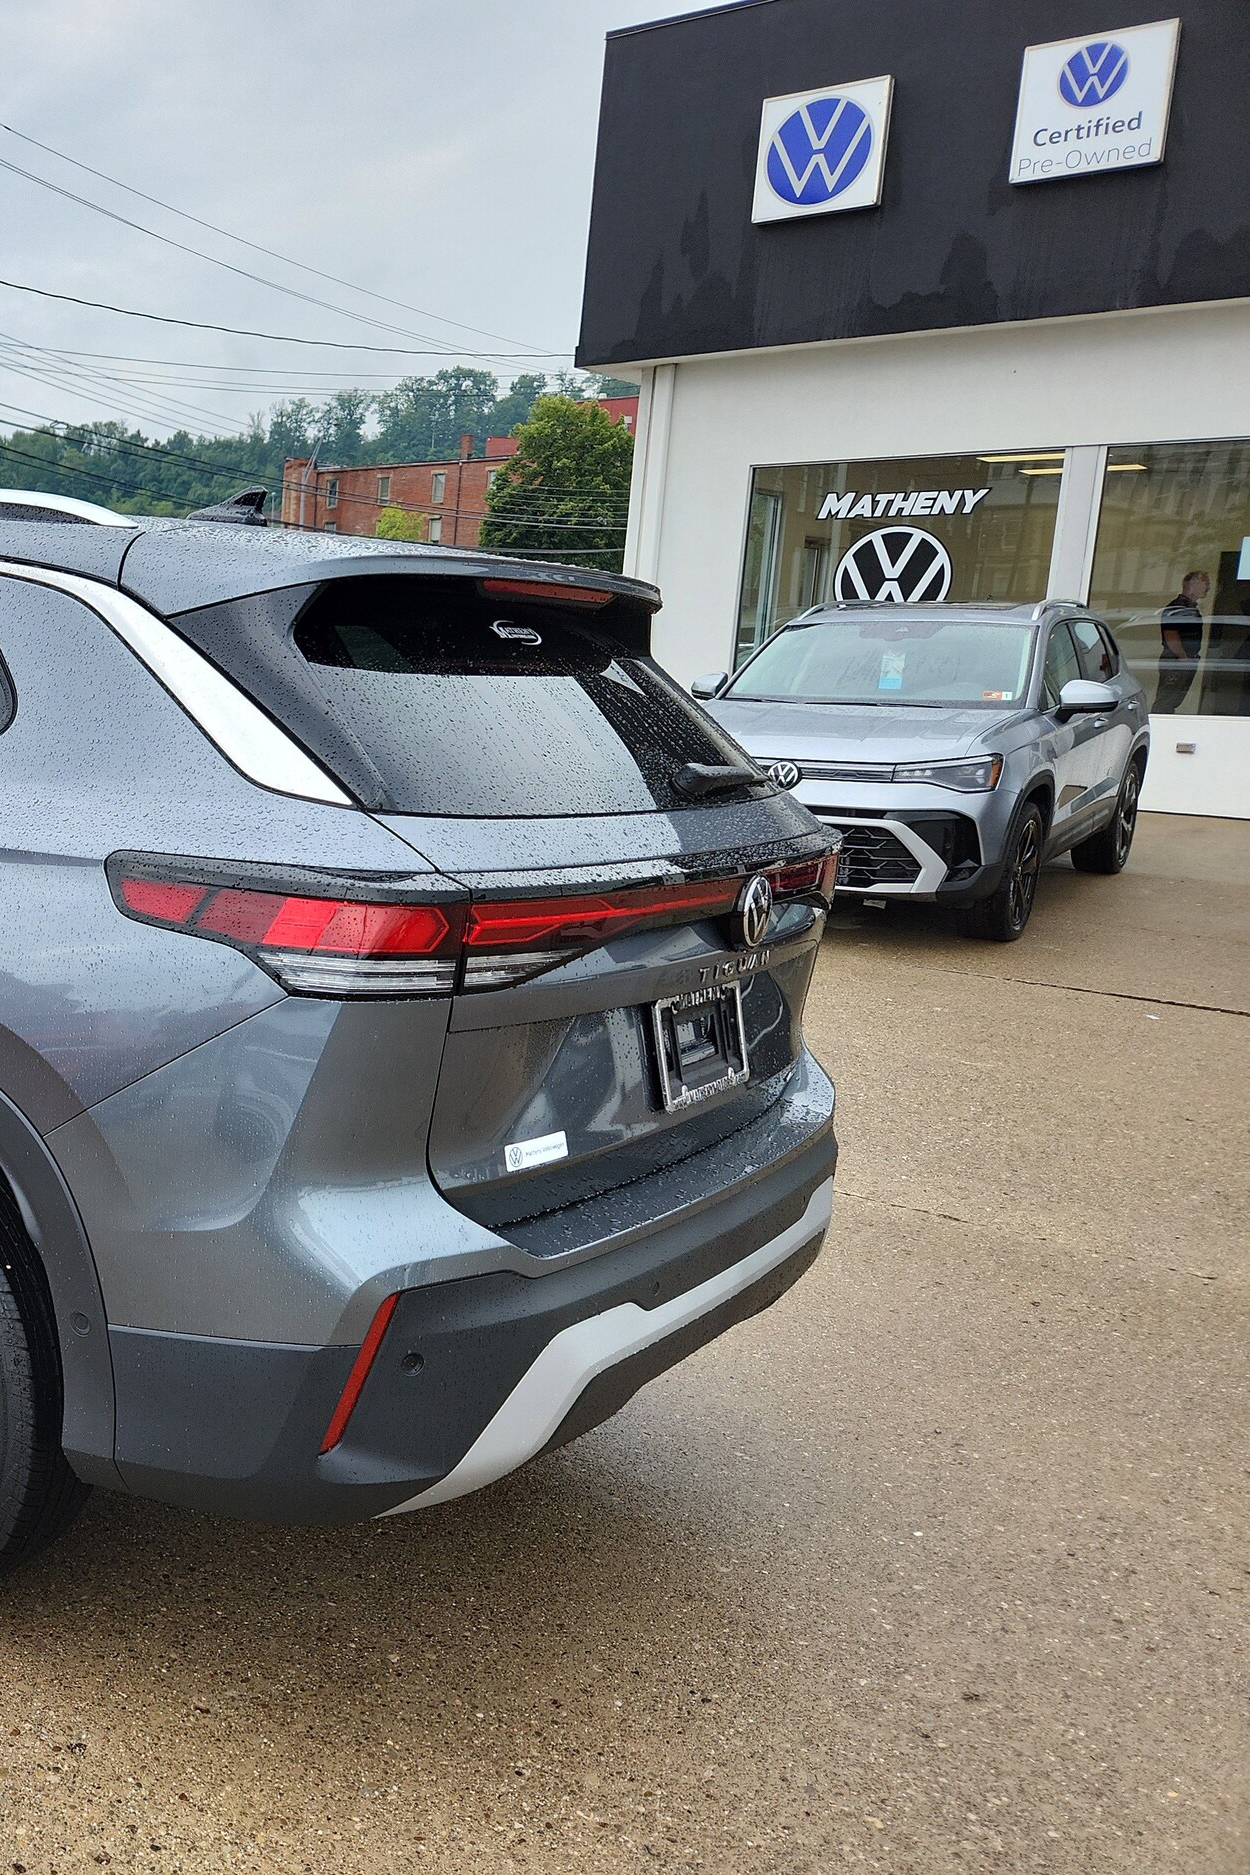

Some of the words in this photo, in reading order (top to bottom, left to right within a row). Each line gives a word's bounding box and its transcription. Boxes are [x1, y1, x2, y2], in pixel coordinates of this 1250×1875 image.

[1058, 41, 1131, 109] VW
[1033, 111, 1143, 146] Certified
[766, 96, 874, 208] VW
[1018, 137, 1153, 177] Pre-Owned
[816, 487, 992, 520] MATHENY
[699, 949, 770, 983] TIGUAN
